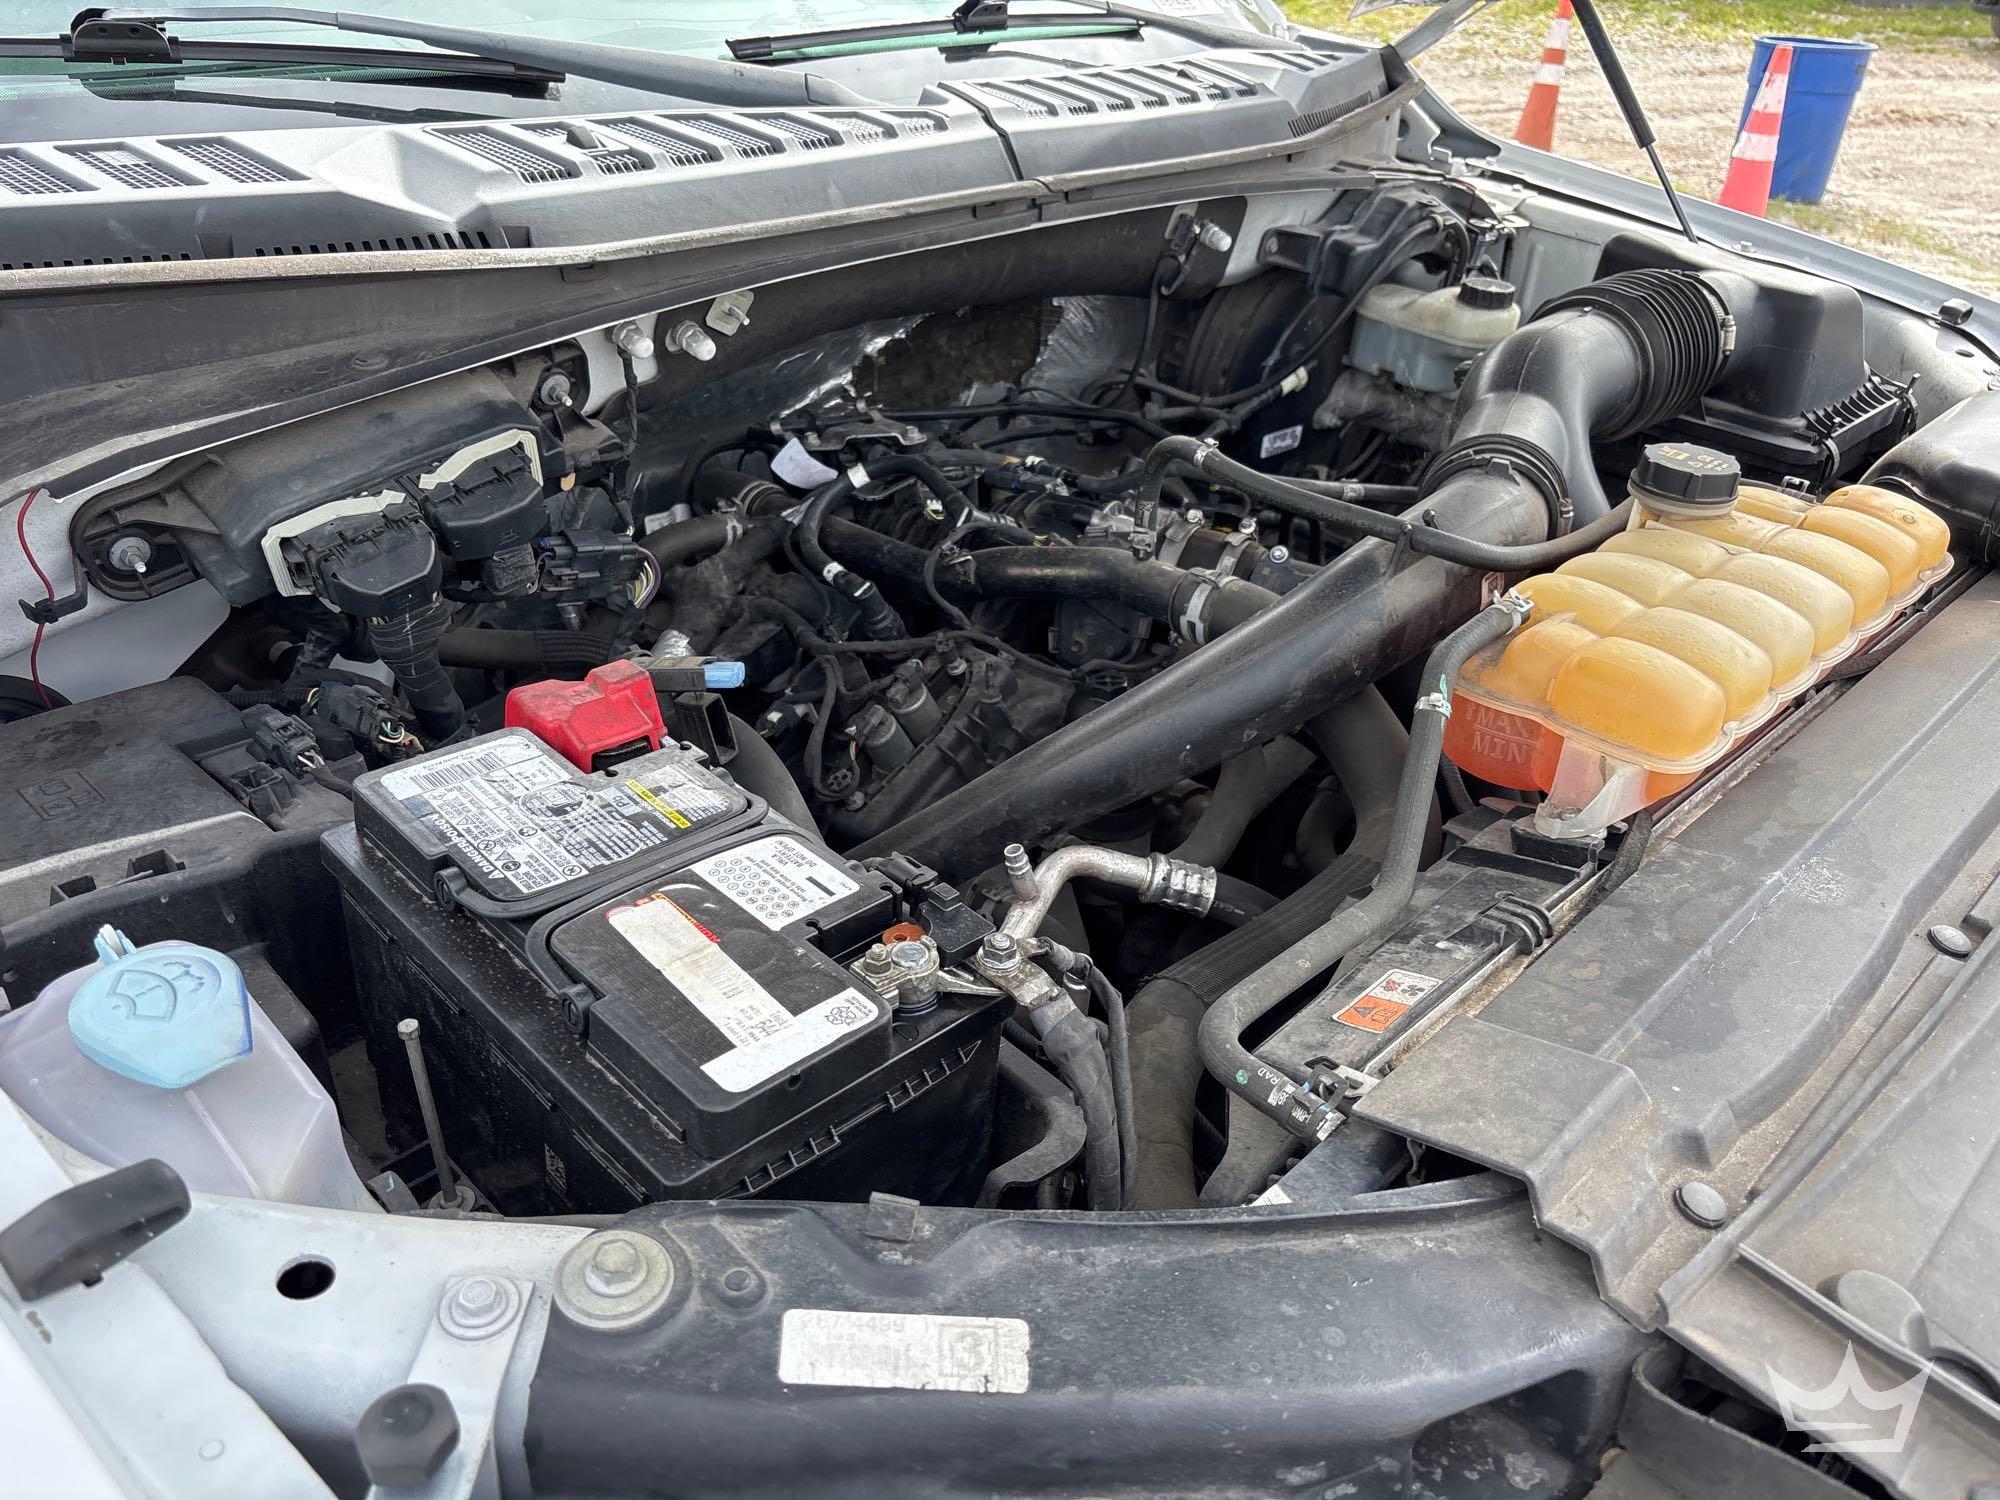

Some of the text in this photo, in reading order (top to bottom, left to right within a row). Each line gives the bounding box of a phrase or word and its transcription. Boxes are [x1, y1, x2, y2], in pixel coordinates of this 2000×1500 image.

[1472, 731, 1528, 766] MIN
[608, 793, 630, 809] Pb
[768, 852, 790, 866] VRLA
[774, 848, 805, 867] BATTERY
[791, 850, 808, 861] NOT
[803, 858, 818, 867] DO
[1257, 1067, 1281, 1085] RAD
